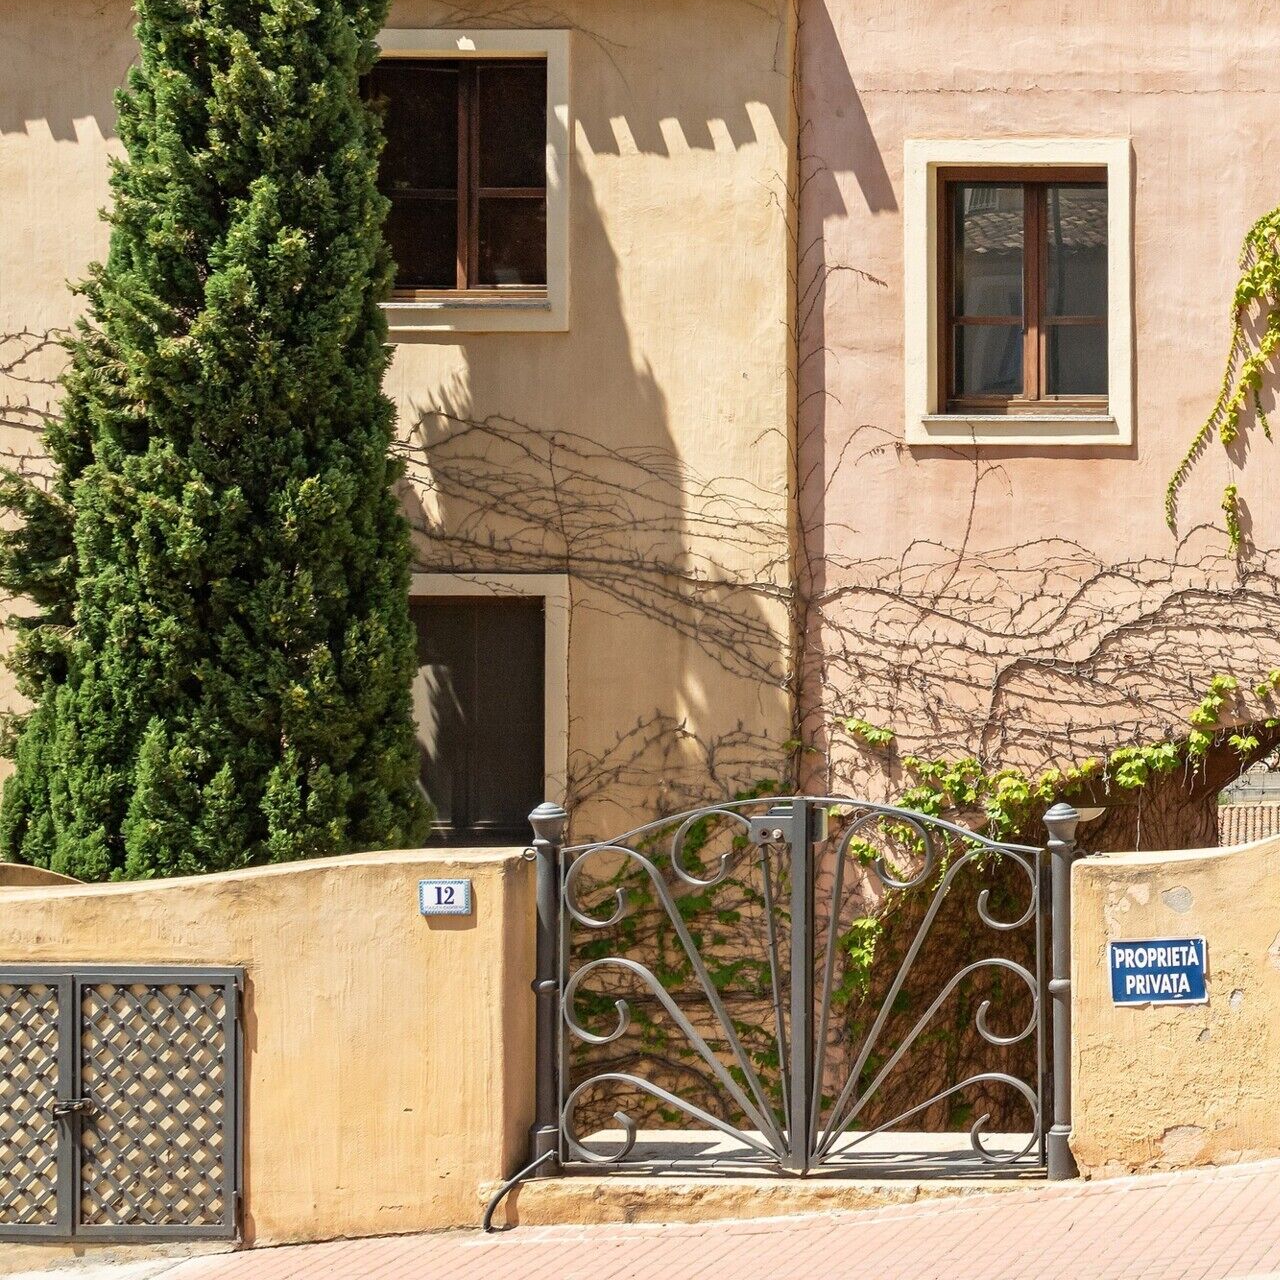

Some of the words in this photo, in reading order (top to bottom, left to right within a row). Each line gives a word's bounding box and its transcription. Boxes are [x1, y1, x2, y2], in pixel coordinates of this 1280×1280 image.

[435, 886, 455, 905] 12
[1115, 940, 1200, 969] PROPRIETÀ
[1125, 973, 1191, 995] PRIVATA
